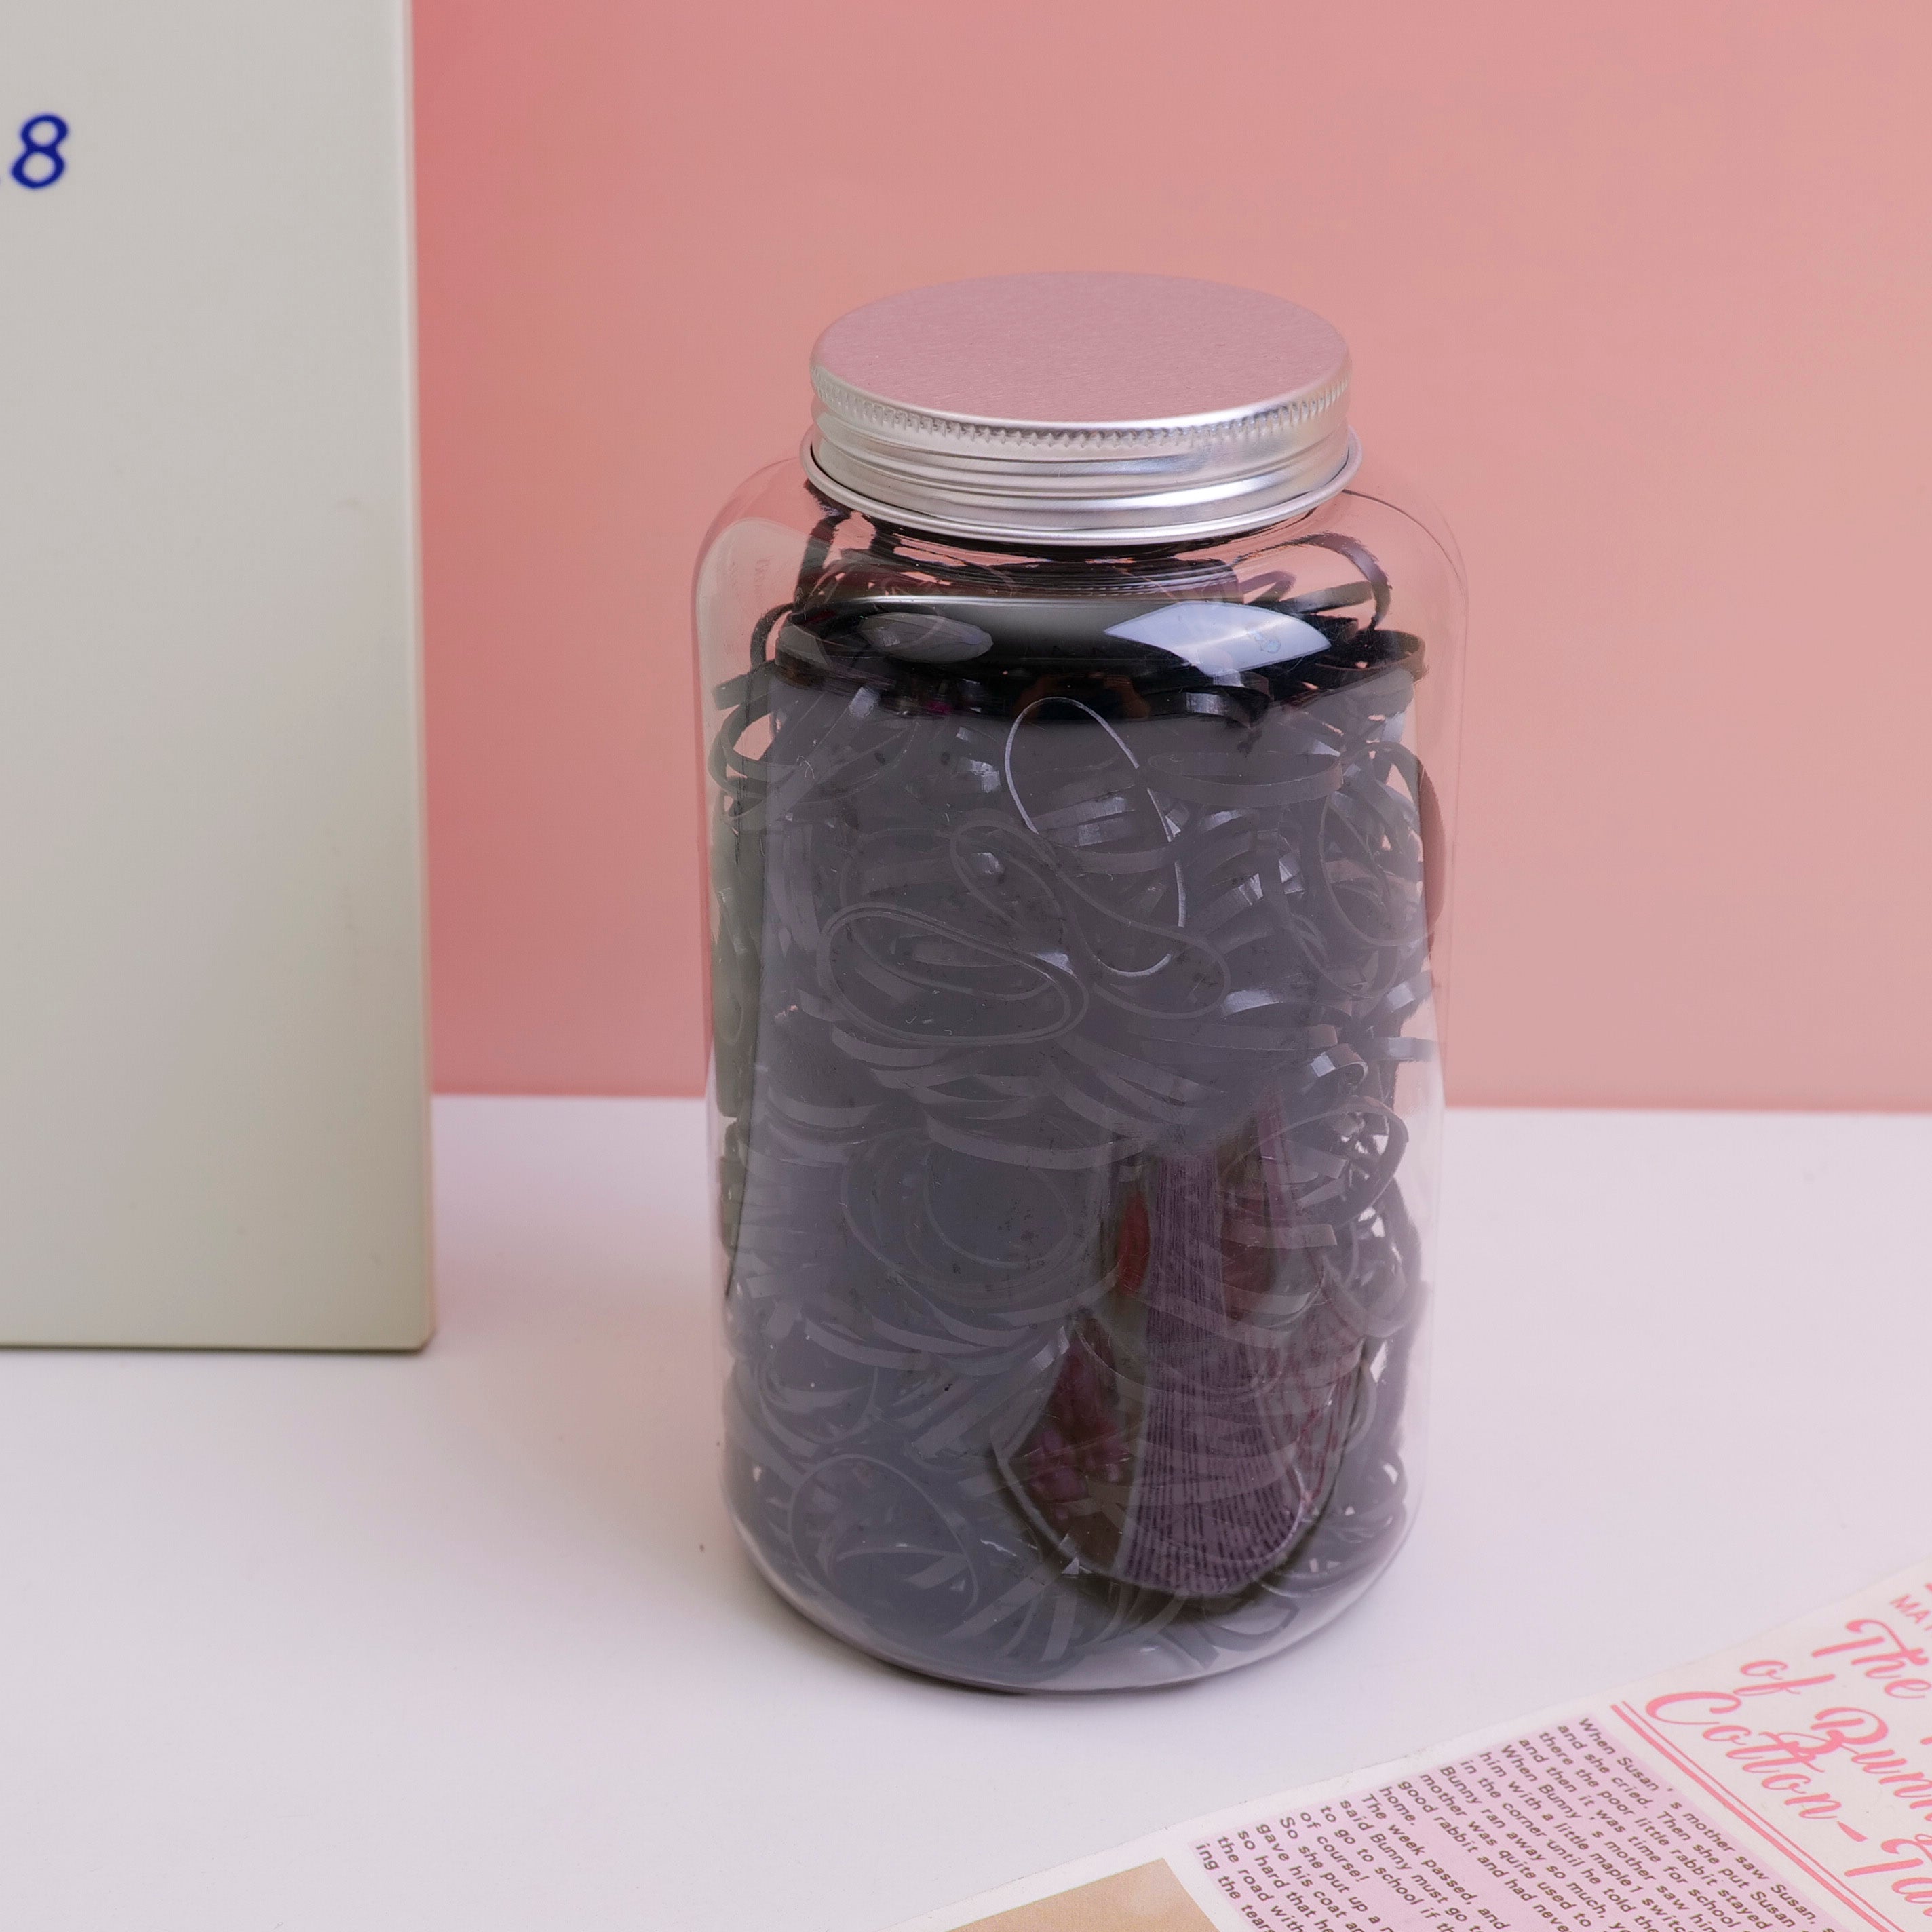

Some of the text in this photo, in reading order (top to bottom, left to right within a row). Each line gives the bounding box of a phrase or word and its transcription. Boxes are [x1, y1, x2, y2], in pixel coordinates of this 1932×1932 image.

[1811, 1619, 1931, 1698] The
[1889, 1593, 1932, 1631] MA
[1733, 1660, 1836, 1697] of
[1300, 1812, 1370, 1882] of course!
[1379, 1786, 1416, 1825] home.
[1397, 1781, 1438, 1813] good
[1434, 1817, 1478, 1853] rabbit
[1477, 1857, 1509, 1877] and
[1504, 1879, 1537, 1901] had
[1420, 1775, 1591, 1927] mother was quite used to
[1440, 1766, 1482, 1803] Bunny
[1481, 1809, 1505, 1828] ran
[1506, 1832, 1546, 1861] away
[1546, 1866, 1566, 1878] so
[1566, 1882, 1606, 1918] much,
[1461, 1760, 1477, 1774] in
[1478, 1778, 1501, 1798] the
[1503, 1803, 1547, 1836] corner
[1547, 1839, 1585, 1867] until
[1581, 1868, 1601, 1884] he
[1603, 1889, 1637, 1912] told
[1479, 1752, 1507, 1777] him
[1509, 1781, 1541, 1810] with
[1554, 1823, 1589, 1850] little
[1501, 1745, 1537, 1781] When
[1604, 1842, 1656, 1880] mother
[1656, 1885, 1689, 1910] saw
[1519, 1740, 1741, 1927] and then it was time for school
[1539, 1732, 1773, 1929] there the poor little rabbit stayed
[1558, 1726, 1795, 1927] and she cried. Then she put Susan
[1579, 1718, 1615, 1754] When
[1683, 1813, 1735, 1851] mother
[1735, 1857, 1769, 1879] saw
[1770, 1884, 1815, 1924] Susan,
[1196, 1843, 1219, 1870] ing
[1218, 1876, 1241, 1899] the
[1217, 1836, 1239, 1863] the
[1237, 1870, 1275, 1901] road
[1237, 1830, 1256, 1850] so
[1254, 1855, 1290, 1889] hard
[1286, 1892, 1316, 1918] that
[1256, 1824, 1289, 1861] gave
[1289, 1866, 1313, 1887] his
[1313, 1891, 1347, 1918] coat
[1280, 1817, 1298, 1839] So
[1298, 1846, 1323, 1868] she
[1319, 1872, 1349, 1893] put
[1348, 1897, 1368, 1912] up
[1321, 1806, 1336, 1822] to
[1334, 1830, 1355, 1844] go
[1357, 1849, 1374, 1862] to
[1374, 1867, 1424, 1905] school
[1420, 1908, 1440, 1918] if
[1340, 1800, 1374, 1830] said
[1370, 1833, 1412, 1870] Bunny
[1411, 1874, 1448, 1904] must
[1444, 1908, 1467, 1921] go
[1362, 1794, 1511, 1929] The week passed, and
